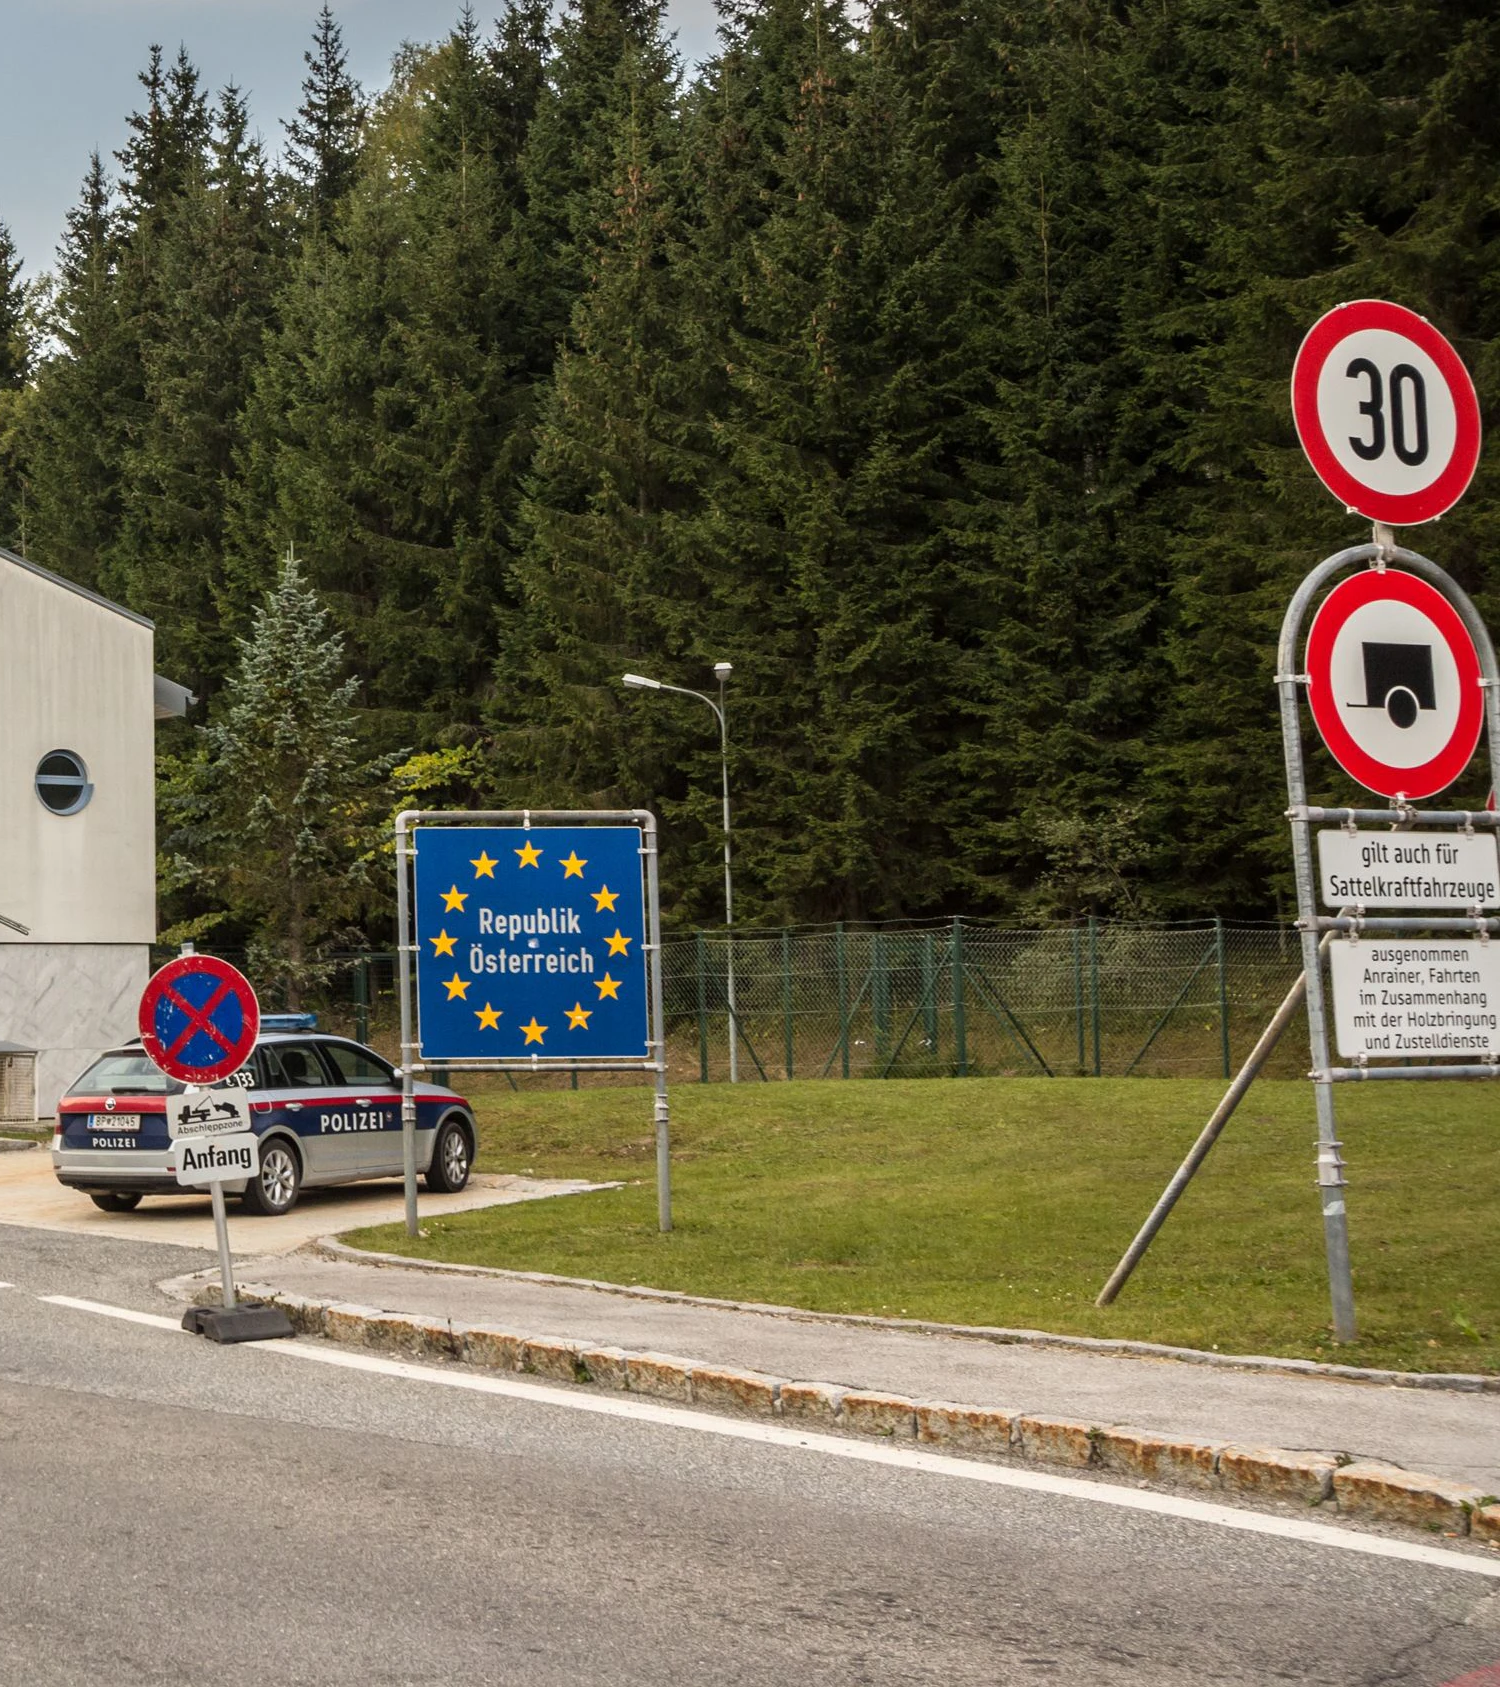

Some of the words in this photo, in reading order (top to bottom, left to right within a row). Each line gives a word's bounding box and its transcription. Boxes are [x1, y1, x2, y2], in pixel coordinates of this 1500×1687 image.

[1345, 357, 1429, 467] 30
[1361, 841, 1389, 867] gilt
[1394, 844, 1430, 864] auch
[1436, 844, 1459, 864] für
[1330, 875, 1495, 902] Sattelkraftfahrzeuge
[479, 908, 581, 941] Republik
[470, 943, 594, 973] Österreich
[1371, 949, 1469, 964] ausgenommen
[1363, 969, 1425, 985] Anrainer,
[1429, 969, 1480, 983] Fahrten
[1360, 990, 1376, 1005] im
[1381, 990, 1487, 1007] Zusammenhang
[1354, 1012, 1376, 1027] mit
[1381, 1012, 1402, 1027] der
[1407, 1012, 1497, 1030] Holzbringung
[1365, 1034, 1390, 1049] und
[1395, 1034, 1489, 1049] Zustelldienste
[234, 1072, 255, 1087] 133
[95, 1116, 106, 1126] BP
[112, 1116, 135, 1127] 21045
[178, 1120, 243, 1135] Abschleppzone
[320, 1112, 384, 1132] POLIZEI
[92, 1138, 136, 1148] POLIZEI
[182, 1145, 252, 1171] Anfang
